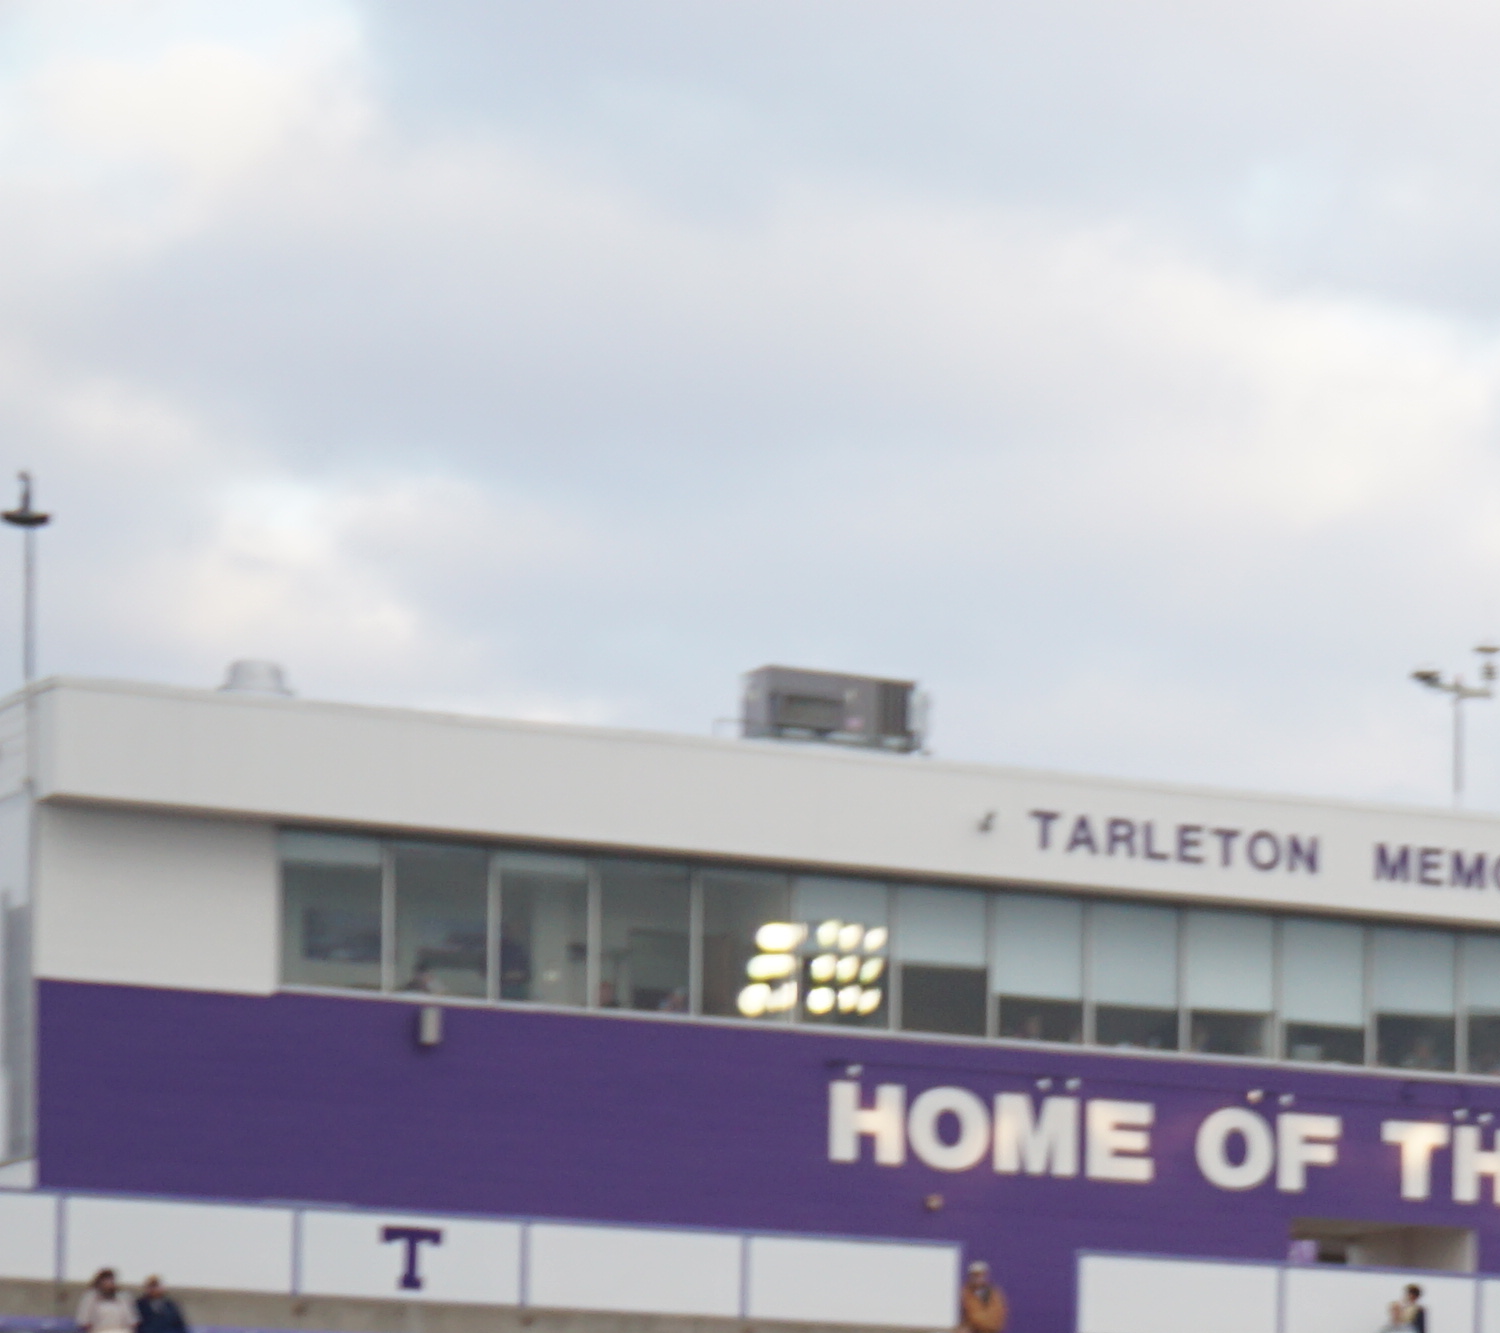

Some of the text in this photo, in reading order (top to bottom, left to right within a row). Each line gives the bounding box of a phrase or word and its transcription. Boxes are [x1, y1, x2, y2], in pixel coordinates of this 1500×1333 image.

[1029, 809, 1319, 875] TARLETON
[828, 1080, 1155, 1182] HOME
[1196, 1105, 1341, 1192] OF
